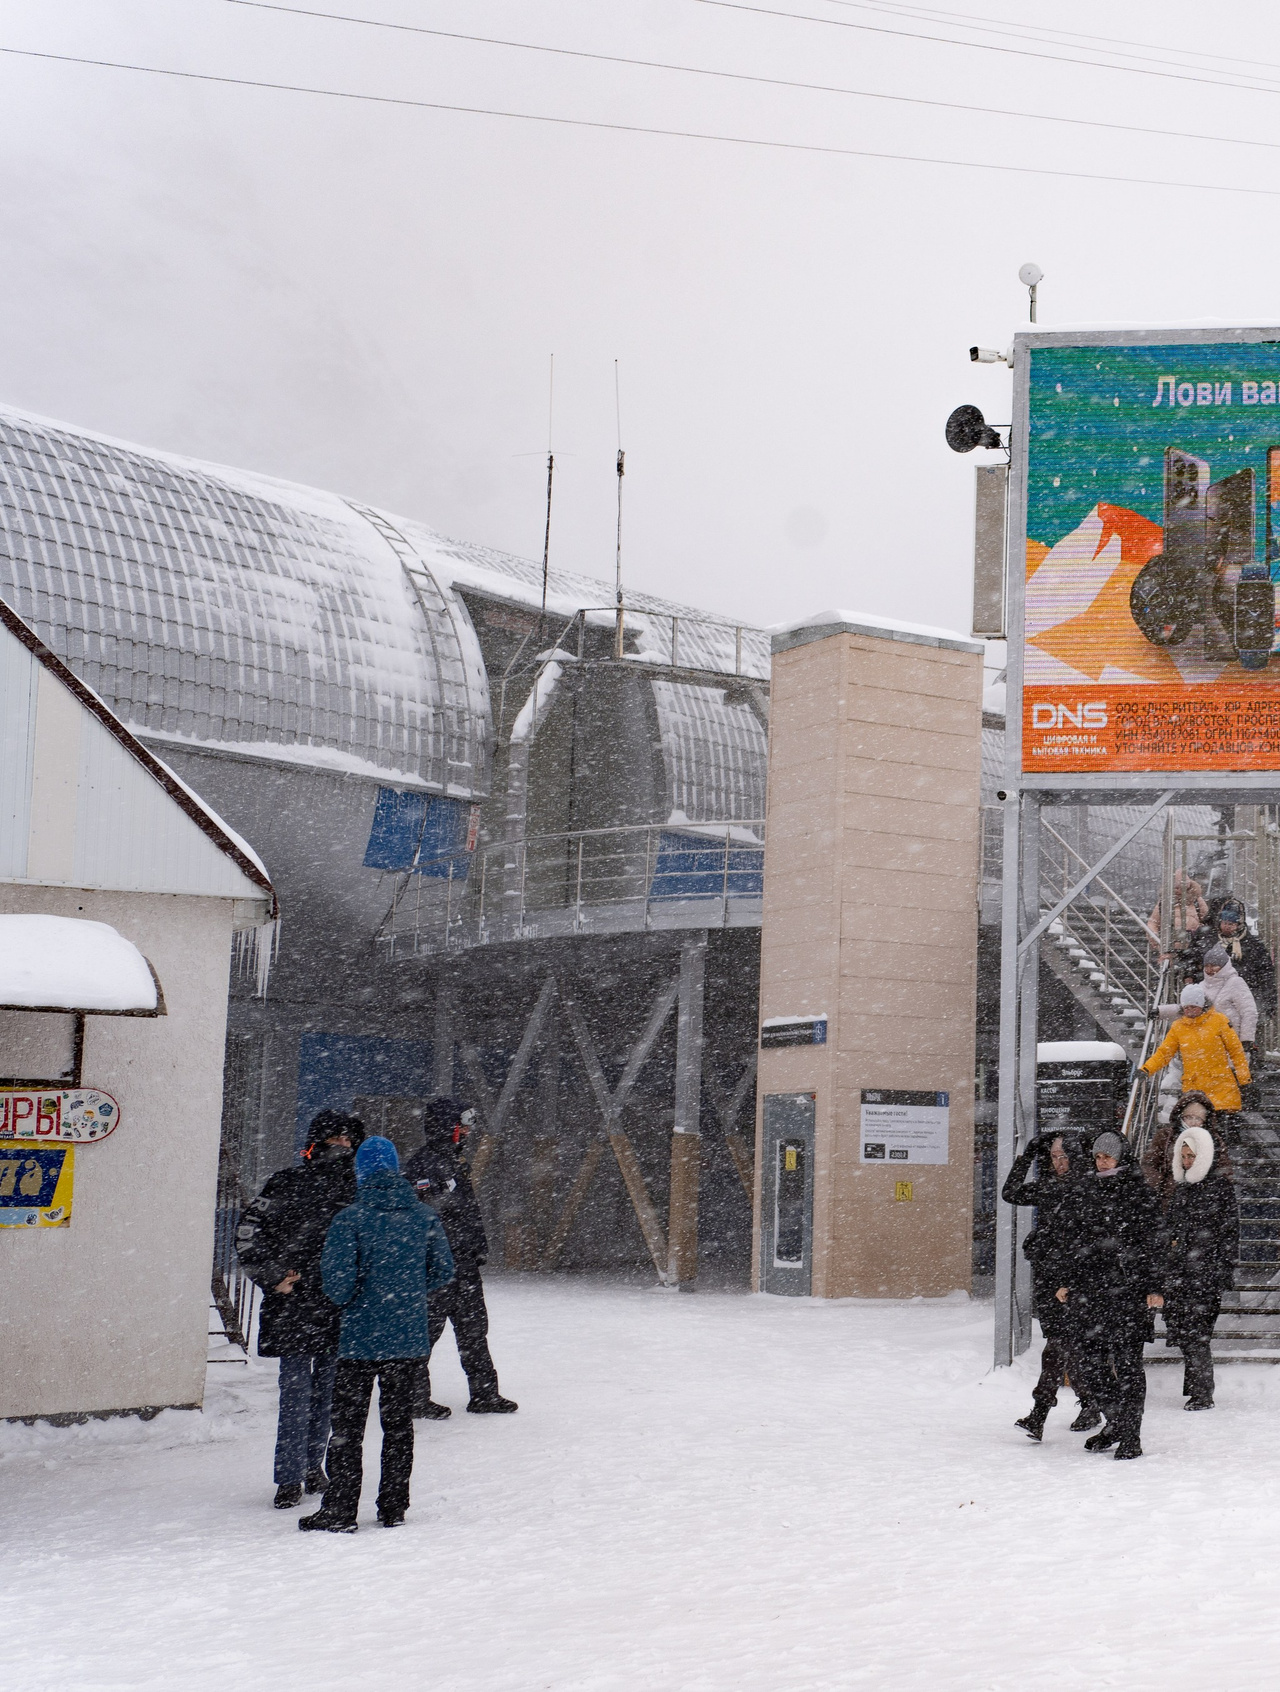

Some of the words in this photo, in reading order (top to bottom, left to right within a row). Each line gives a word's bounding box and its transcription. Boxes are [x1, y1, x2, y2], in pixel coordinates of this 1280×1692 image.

[1153, 375, 1232, 407] Лови
[1115, 702, 1139, 714] ООО
[1032, 702, 1108, 729] DNS
[1115, 715, 1151, 729] ГОРОД
[1153, 714, 1234, 728] ВЛАДИВОСТОК,
[1043, 735, 1088, 745] ЦИФРОВАЯ
[1115, 728, 1139, 741] ИНН
[1205, 727, 1232, 740] ОГРН
[1071, 746, 1107, 756] ТЕХНИКА
[1115, 740, 1178, 755] УТОЧНЯЙТЕ
